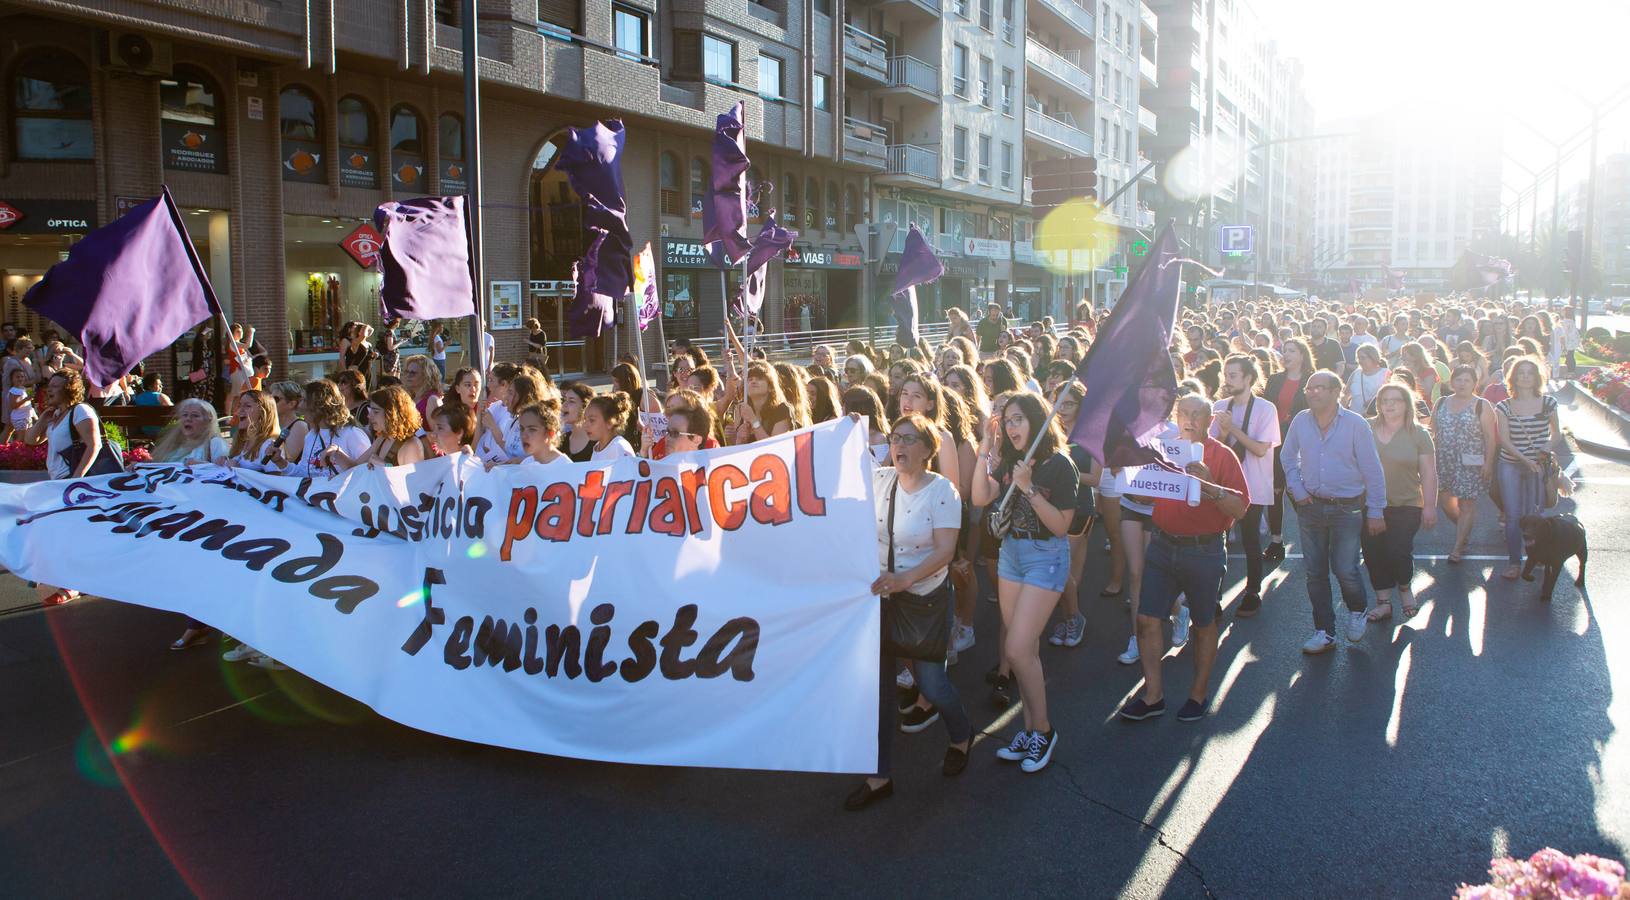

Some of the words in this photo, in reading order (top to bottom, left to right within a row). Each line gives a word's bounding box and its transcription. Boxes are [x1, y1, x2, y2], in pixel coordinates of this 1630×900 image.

[675, 243, 705, 256] FLEX
[667, 256, 706, 264] GALLERY
[803, 252, 825, 265] VIAS
[1130, 479, 1181, 494] nuestras
[352, 480, 492, 543] justicia
[500, 431, 826, 561] patriarcal
[401, 567, 761, 683] Feminista
